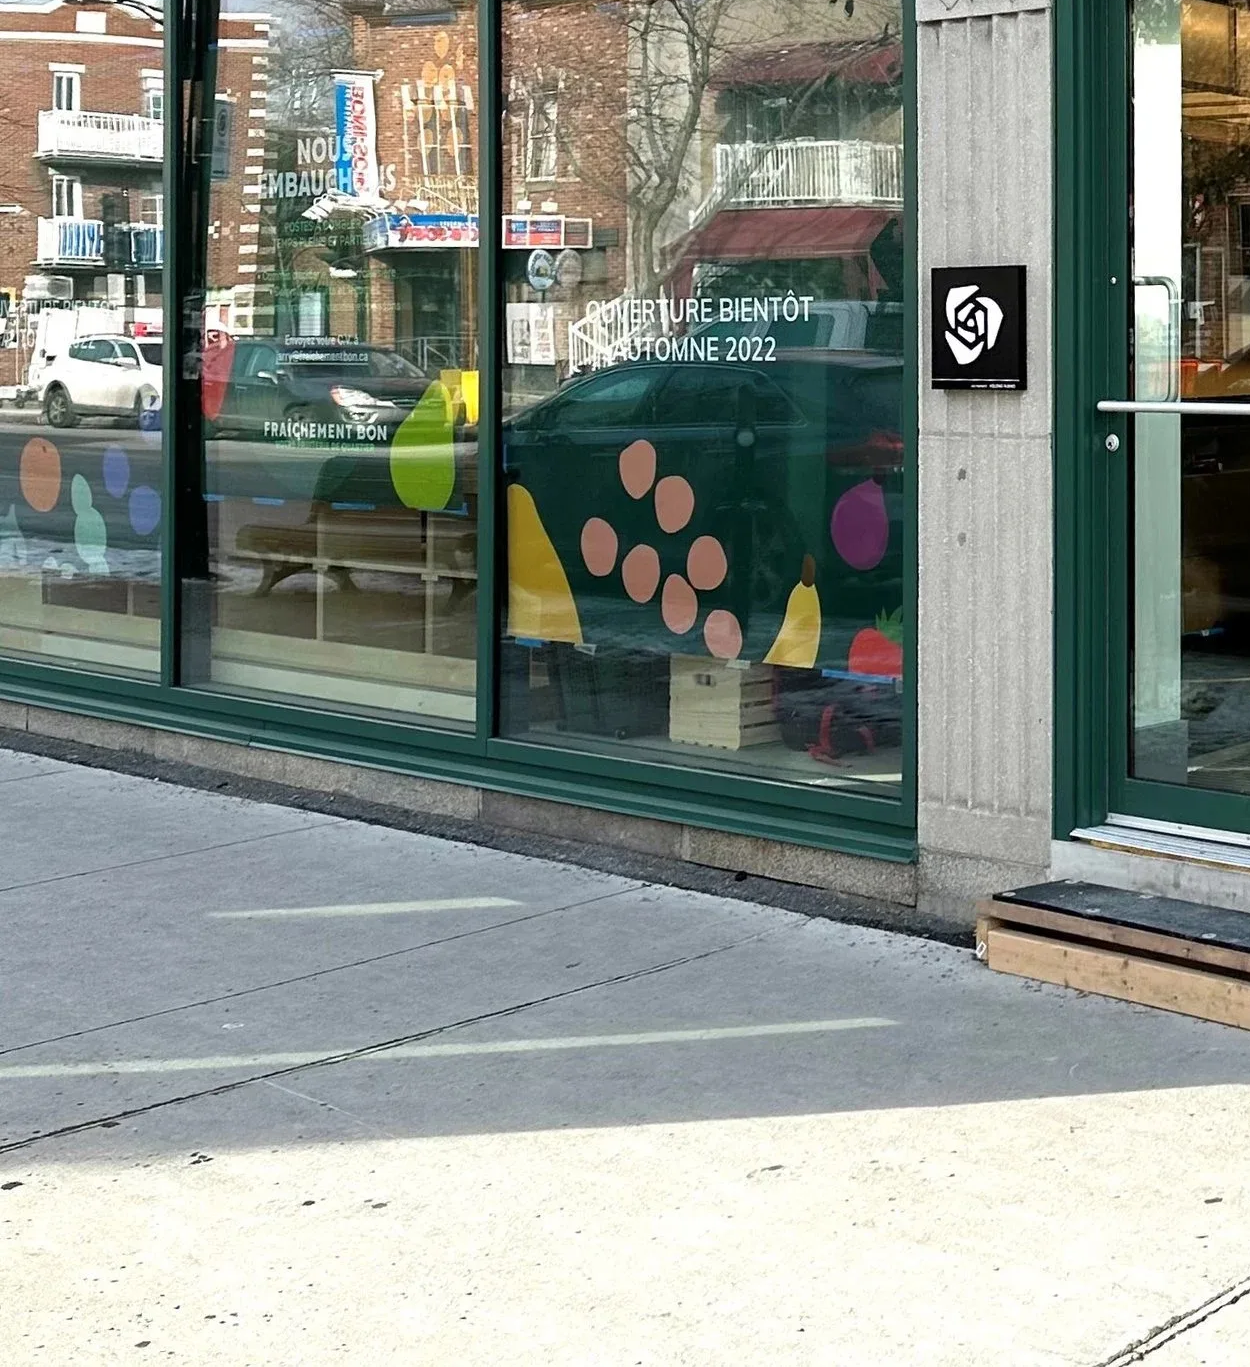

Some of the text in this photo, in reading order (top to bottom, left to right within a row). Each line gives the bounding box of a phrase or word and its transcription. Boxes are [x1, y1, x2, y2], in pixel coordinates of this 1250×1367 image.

[297, 136, 353, 164] NOUS
[258, 163, 396, 199] EMBAUCHS
[586, 289, 814, 323] OUVERTURE BIENTÔT
[611, 336, 777, 362] AUTOMNE 2022
[263, 418, 387, 440] FRAÎCHEMENT BON
